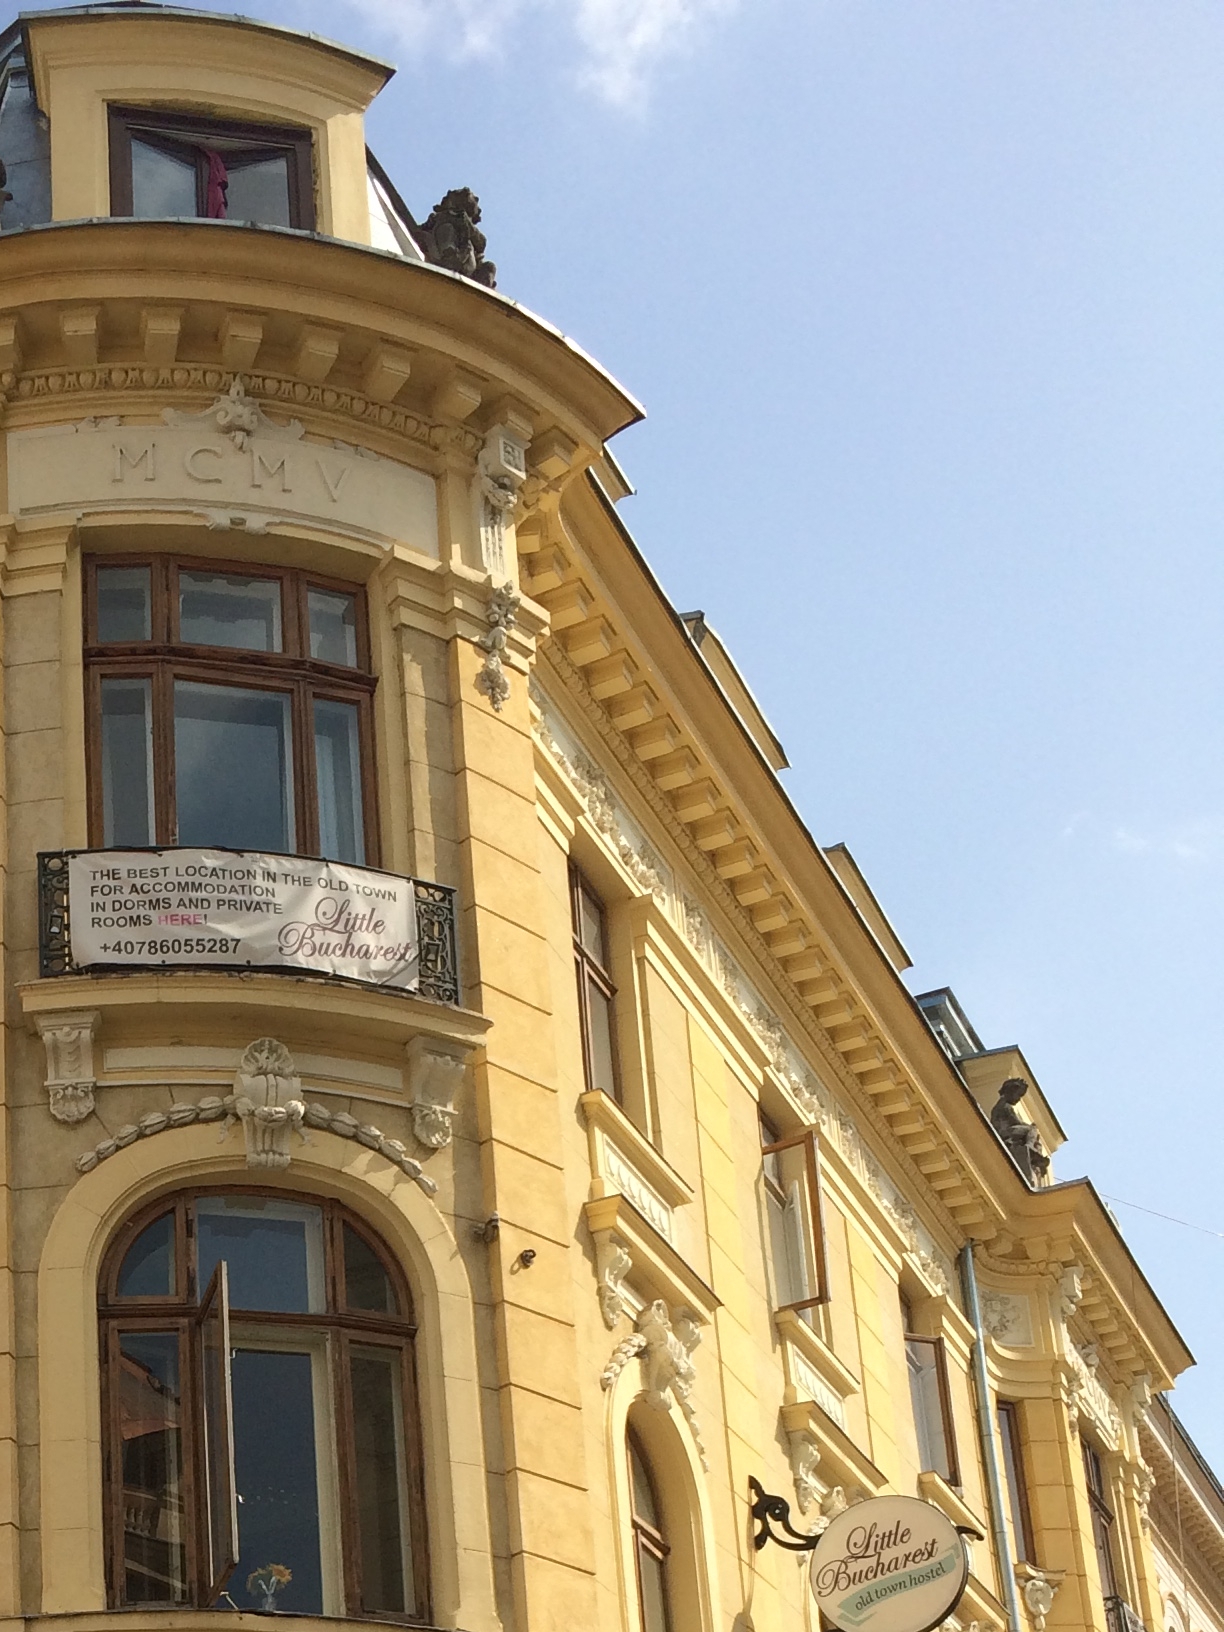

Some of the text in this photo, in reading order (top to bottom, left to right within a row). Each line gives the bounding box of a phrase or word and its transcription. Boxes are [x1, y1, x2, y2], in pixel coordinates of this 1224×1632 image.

[111, 443, 353, 502] MCMV
[89, 866, 397, 903] THE BEST LOCATION IN THE OLD TOWN
[90, 882, 276, 899] FOR ACCOMMODATION
[90, 896, 283, 915] IN DORMS AND PRIVATE
[90, 913, 208, 928] ROOMS HERE!
[314, 896, 386, 935] Little
[99, 937, 242, 956] +40786055287
[277, 921, 413, 963] Bucharest
[846, 1520, 912, 1562] Little
[815, 1538, 939, 1598] Bucharest
[855, 1562, 946, 1611] old town hostel
